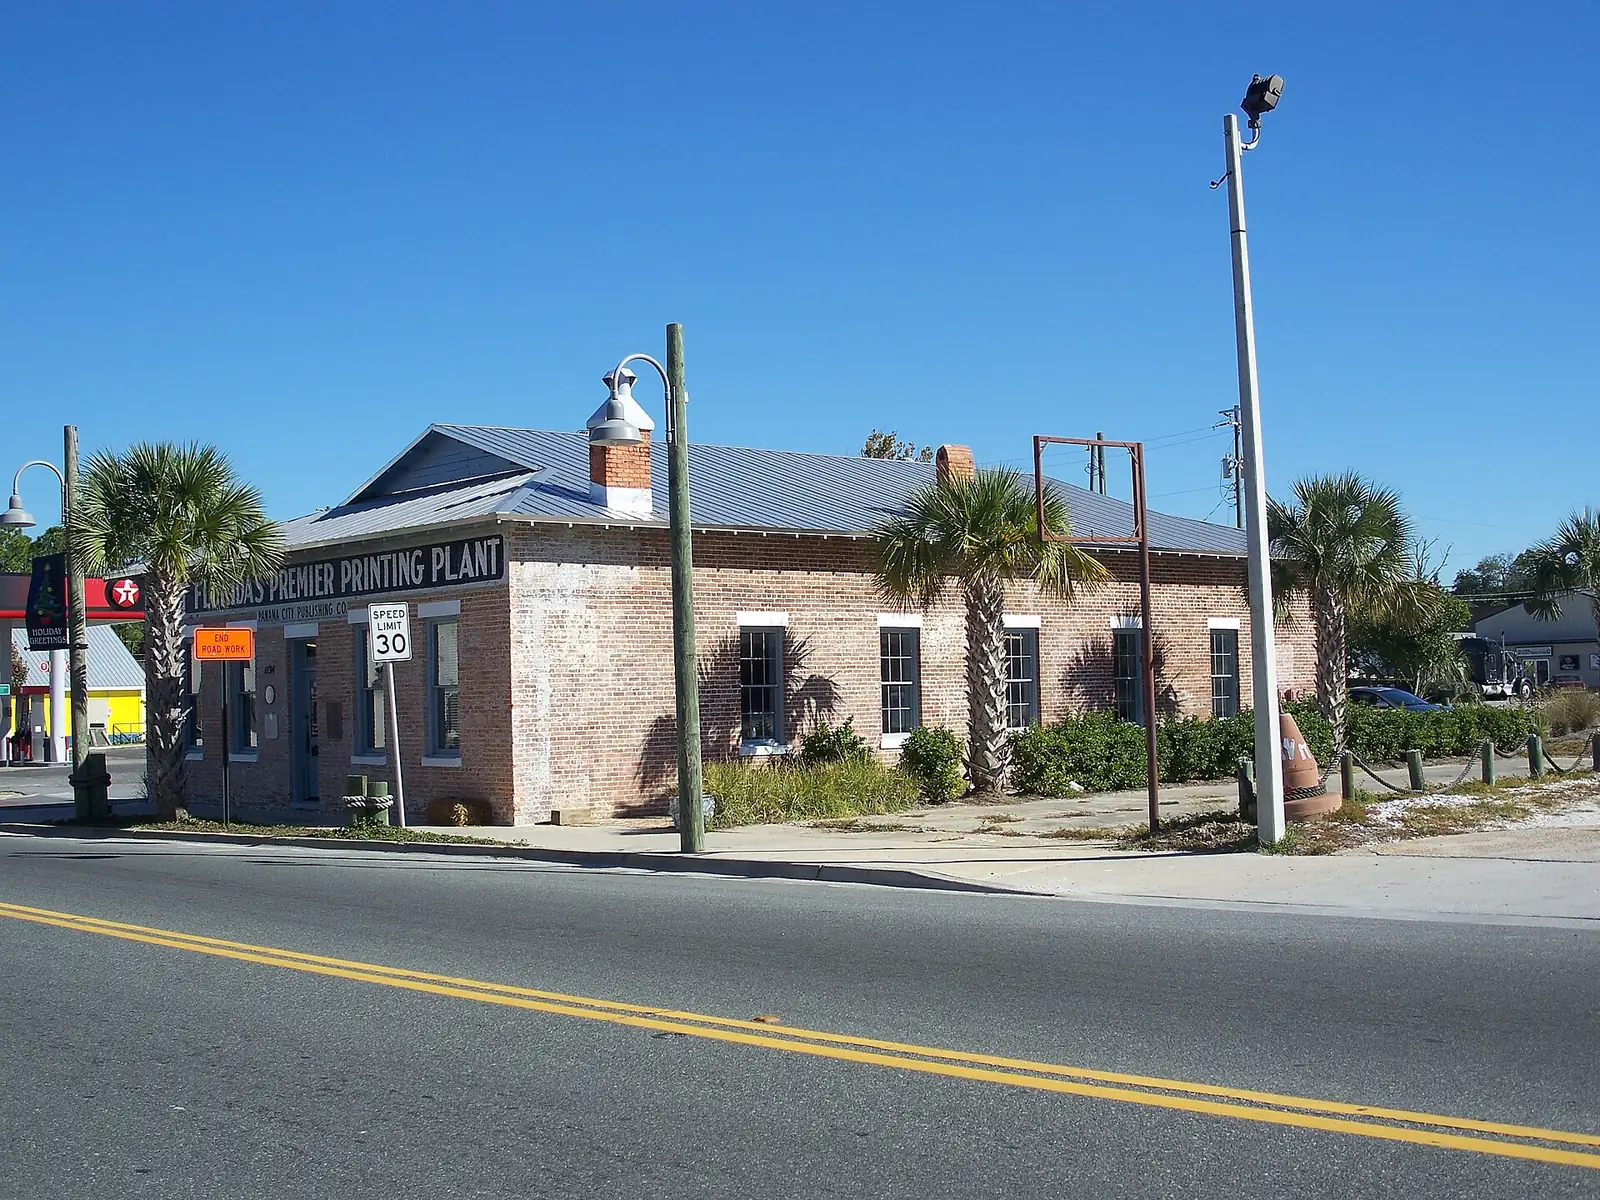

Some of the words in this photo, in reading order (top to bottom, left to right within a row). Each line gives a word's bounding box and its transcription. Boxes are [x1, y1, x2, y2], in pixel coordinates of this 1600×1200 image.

[269, 562, 335, 602] PREMIER
[341, 549, 425, 593] PRINTING
[432, 537, 500, 583] PLANT
[281, 607, 294, 620] CITY
[297, 602, 333, 619] PUBLISHING
[336, 601, 348, 615] CO.
[373, 609, 405, 620] SPEED
[377, 621, 402, 631] LIMIT
[32, 627, 62, 636] HOLIDAY
[30, 635, 67, 645] GREETINGS
[214, 634, 229, 643] END
[376, 633, 406, 654] 30
[201, 645, 222, 654] ROAD
[225, 645, 245, 653] WORK
